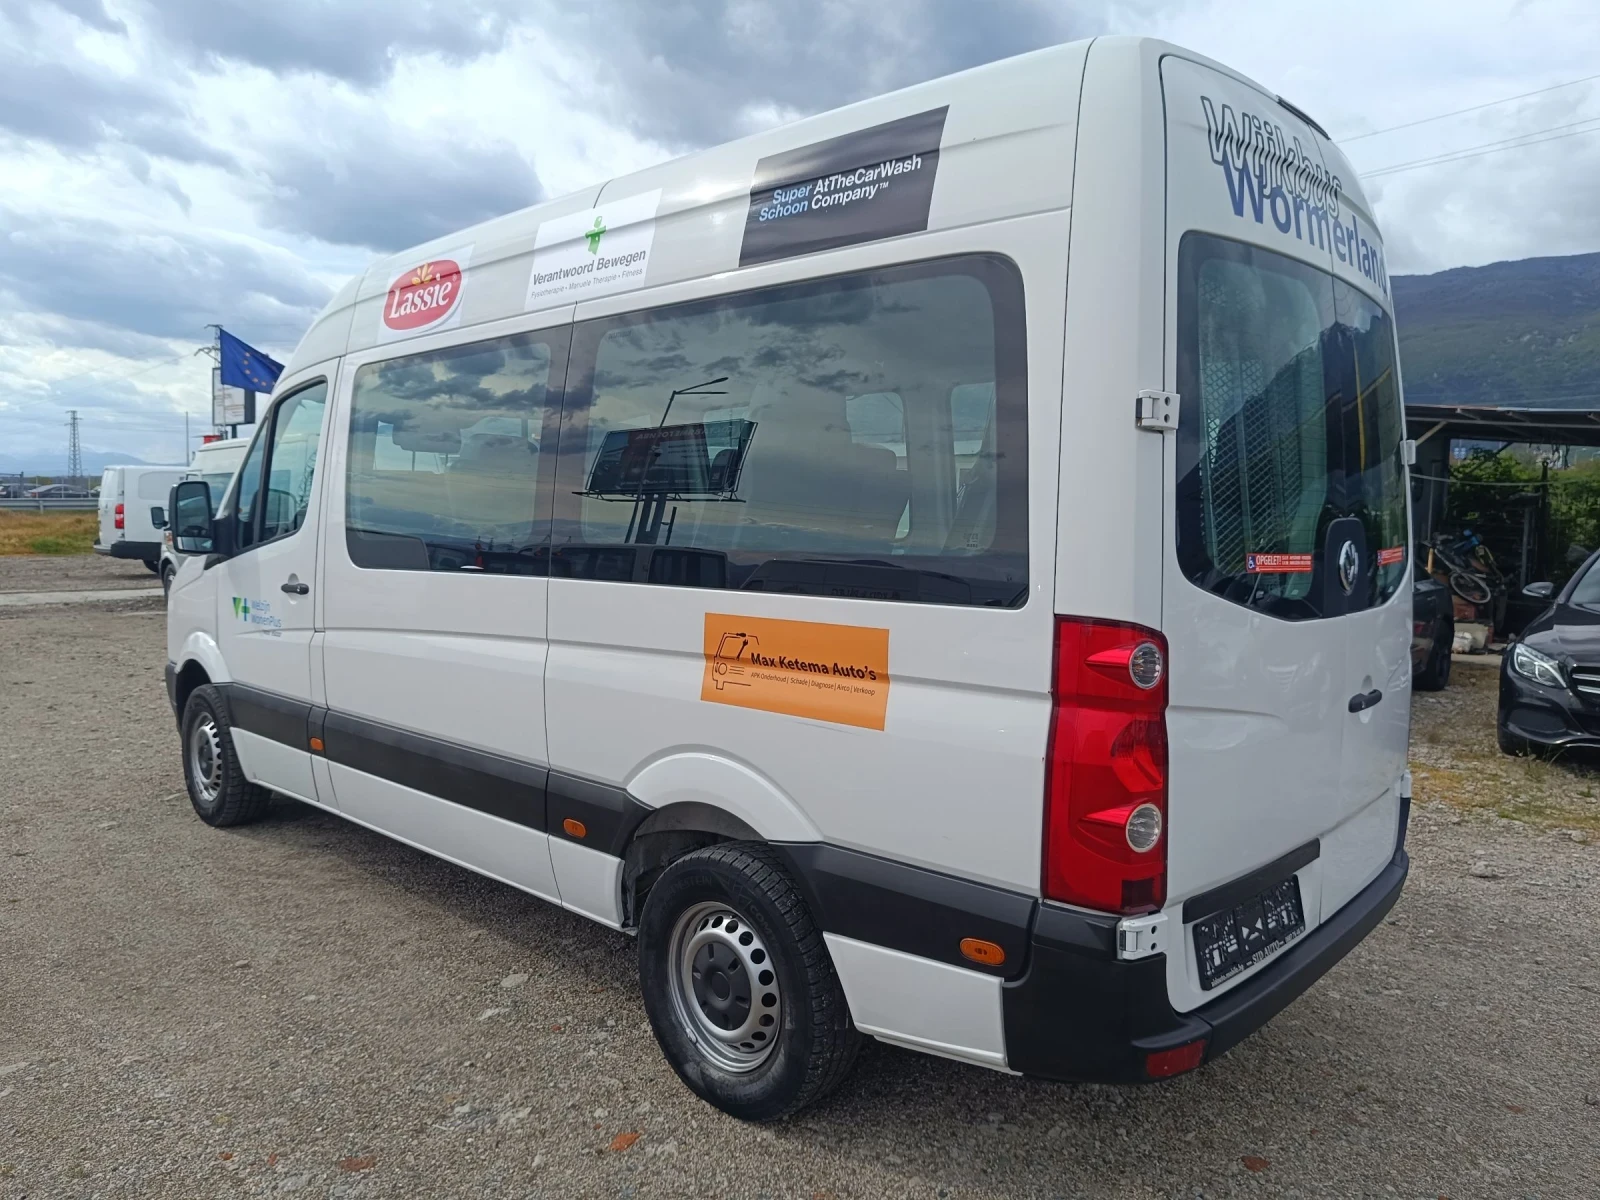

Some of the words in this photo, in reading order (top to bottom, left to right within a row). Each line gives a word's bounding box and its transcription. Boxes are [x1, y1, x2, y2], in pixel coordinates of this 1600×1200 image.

[1200, 95, 1342, 219] Wijkbus
[773, 182, 813, 205] Super
[813, 154, 922, 196] AtTheCarWash
[759, 200, 808, 222] Schoon
[533, 260, 595, 286] Verantwoord
[596, 249, 647, 271] Bewegen
[388, 273, 452, 319] Lassie
[531, 285, 565, 299] Fysiotherapie
[568, 279, 592, 290] Manuele
[593, 274, 617, 286] Therapie
[621, 268, 643, 279] Fitness
[1256, 555, 1282, 566] OPGELET!
[750, 652, 777, 668] Max
[778, 655, 829, 675] Ketema
[833, 662, 877, 681] Auto's
[761, 673, 787, 683] Onderhoud
[790, 677, 809, 686] Schade
[811, 680, 834, 690] Diagnose
[837, 684, 851, 692] Airco
[853, 686, 876, 696] Verkoop
[1264, 940, 1280, 957] AUTO
